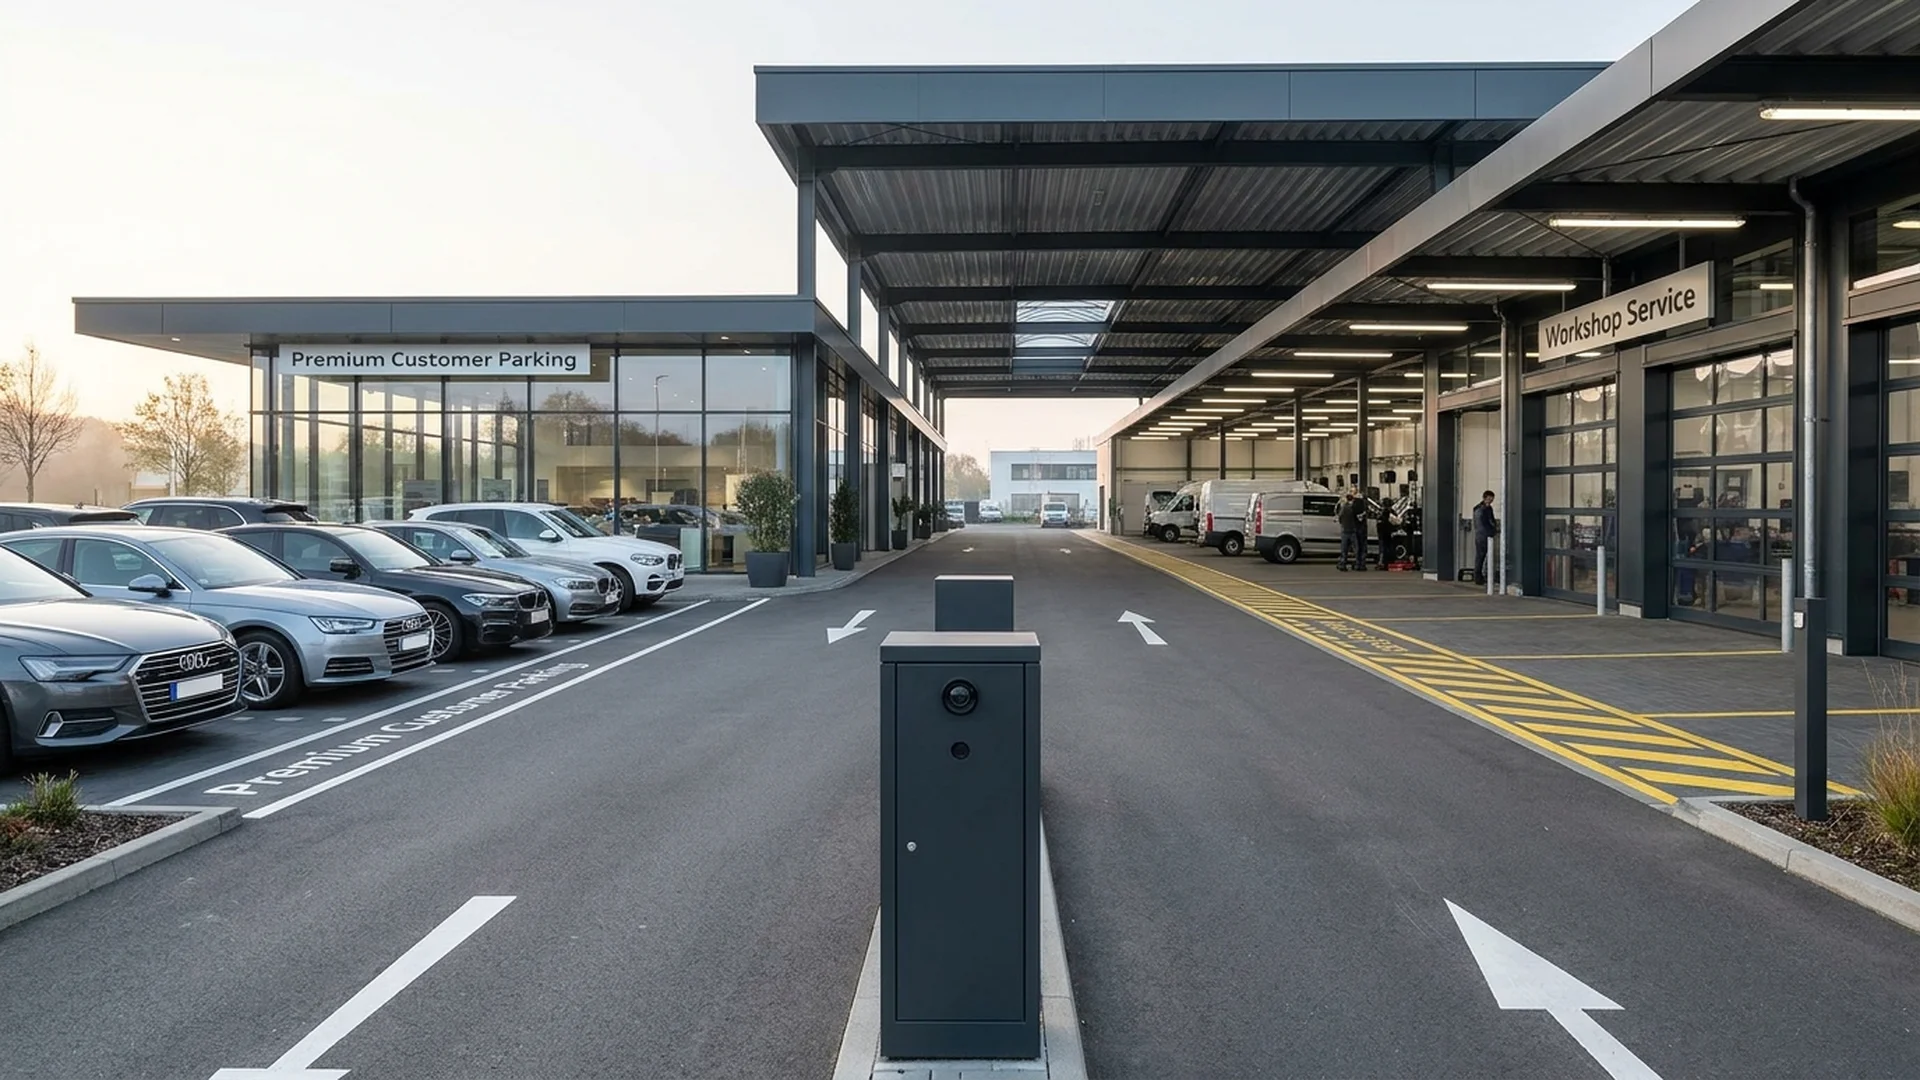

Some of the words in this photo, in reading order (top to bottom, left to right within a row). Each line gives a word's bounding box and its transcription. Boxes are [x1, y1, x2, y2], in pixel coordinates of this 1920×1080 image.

[1545, 311, 1622, 348] Workshop
[1627, 287, 1695, 326] Service
[292, 351, 384, 367] Premium
[391, 351, 492, 367] Customer
[499, 351, 577, 371] Parking
[203, 733, 402, 795] Premium
